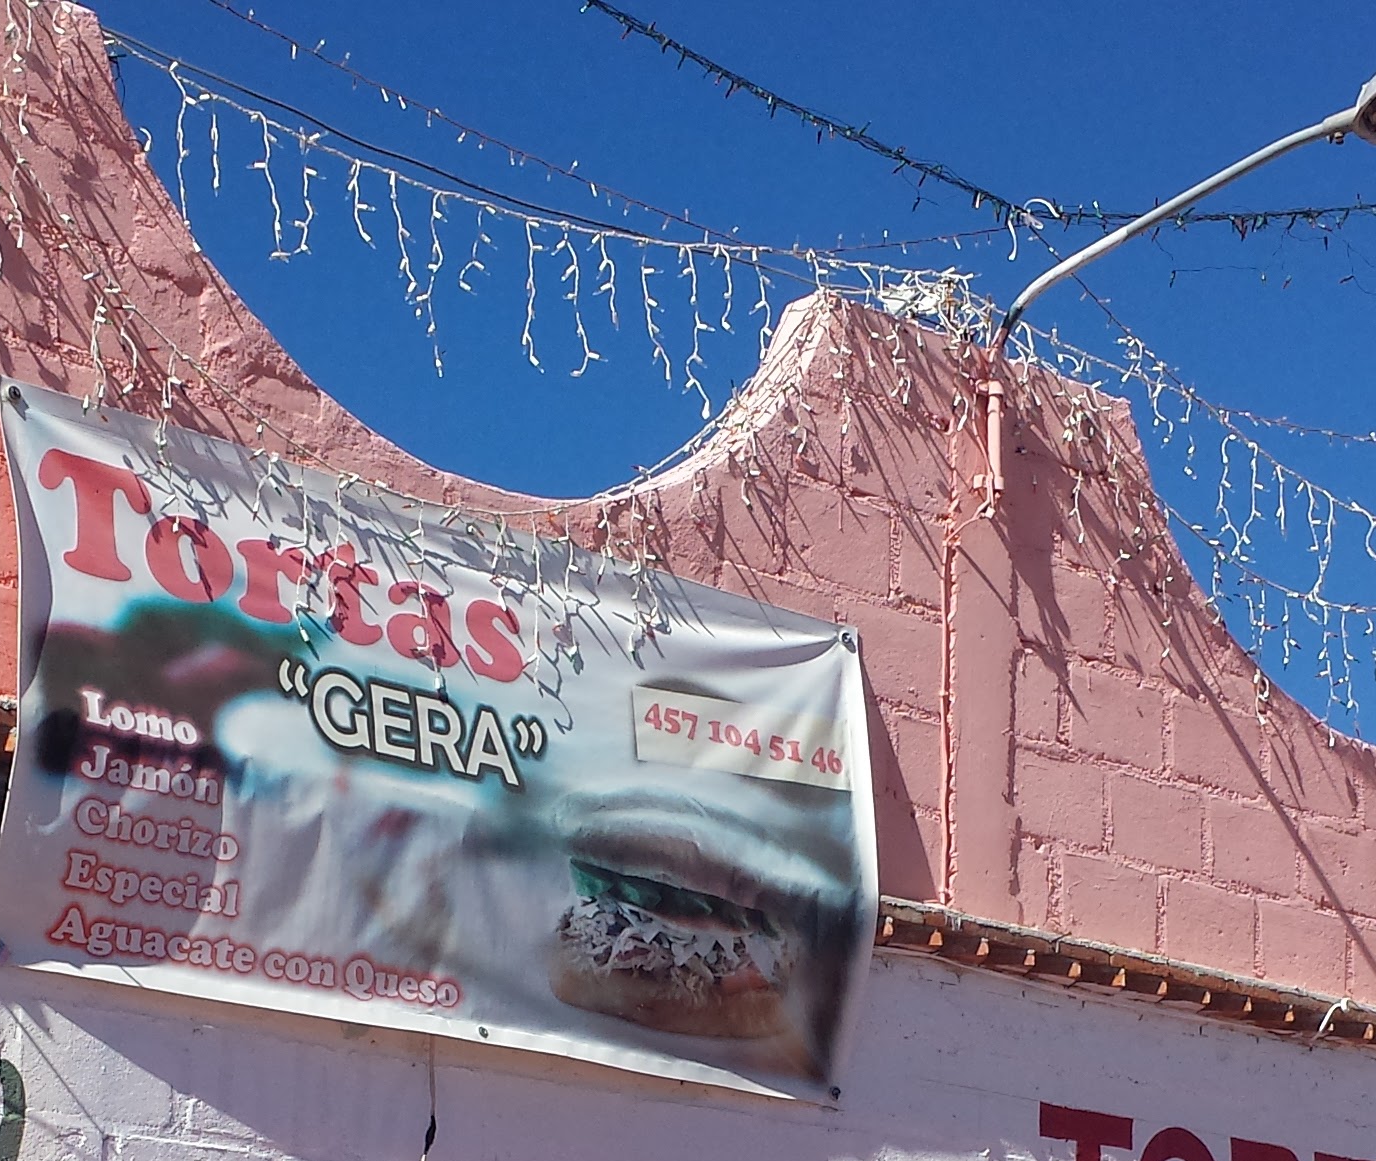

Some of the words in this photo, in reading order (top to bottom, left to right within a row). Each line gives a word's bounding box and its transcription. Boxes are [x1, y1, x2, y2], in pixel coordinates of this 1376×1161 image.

[37, 447, 526, 683] Tortas
[81, 690, 199, 746] Lomo
[644, 703, 699, 740] 457
[708, 720, 762, 756] 104
[769, 735, 804, 763] 51
[811, 746, 843, 775] 46
[80, 744, 221, 805] Jamón
[76, 798, 240, 862] Chorizo
[64, 852, 240, 917] Especial
[50, 906, 256, 974] Aguacate
[264, 950, 335, 988] con
[343, 956, 461, 1008] Queso
